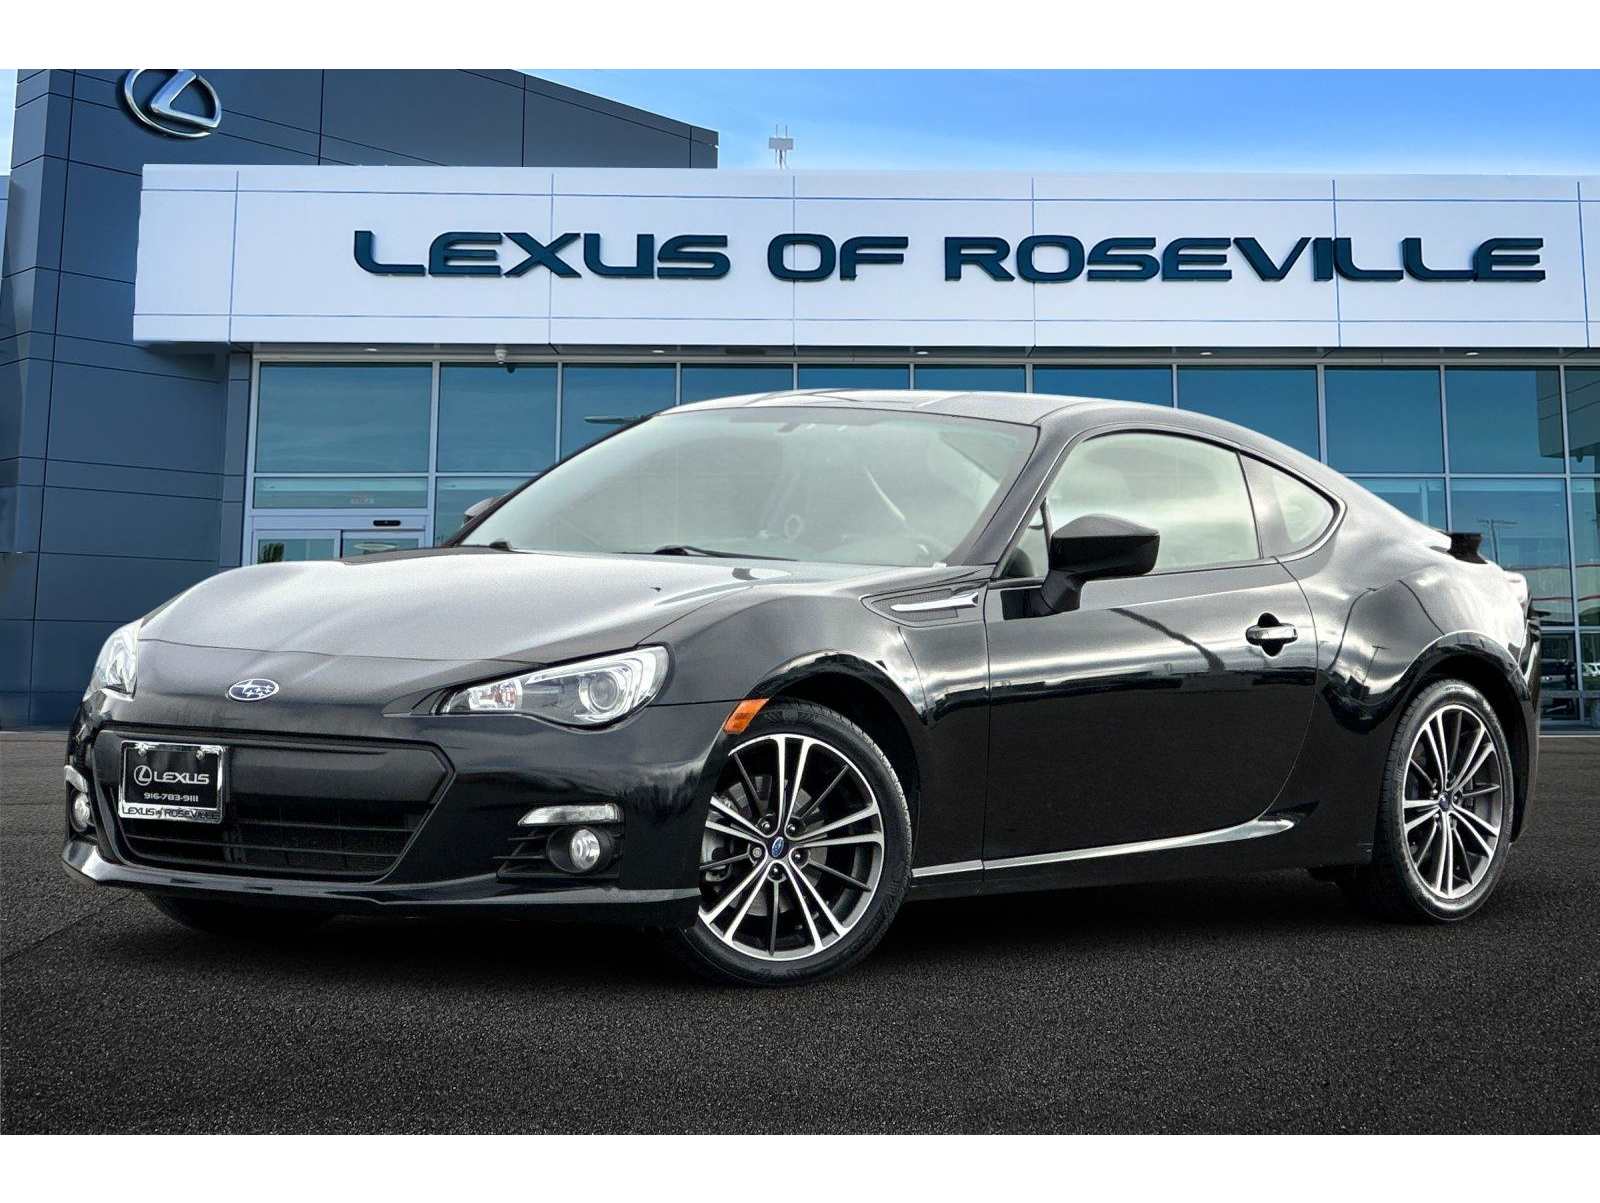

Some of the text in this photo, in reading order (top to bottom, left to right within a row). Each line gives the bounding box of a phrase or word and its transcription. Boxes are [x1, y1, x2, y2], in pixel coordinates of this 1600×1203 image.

[354, 231, 1545, 282] LEXUS OF ROSEVILLE
[154, 771, 210, 785] LEXUS
[144, 792, 199, 802] 916-783-9111
[122, 806, 155, 816] LEXUS
